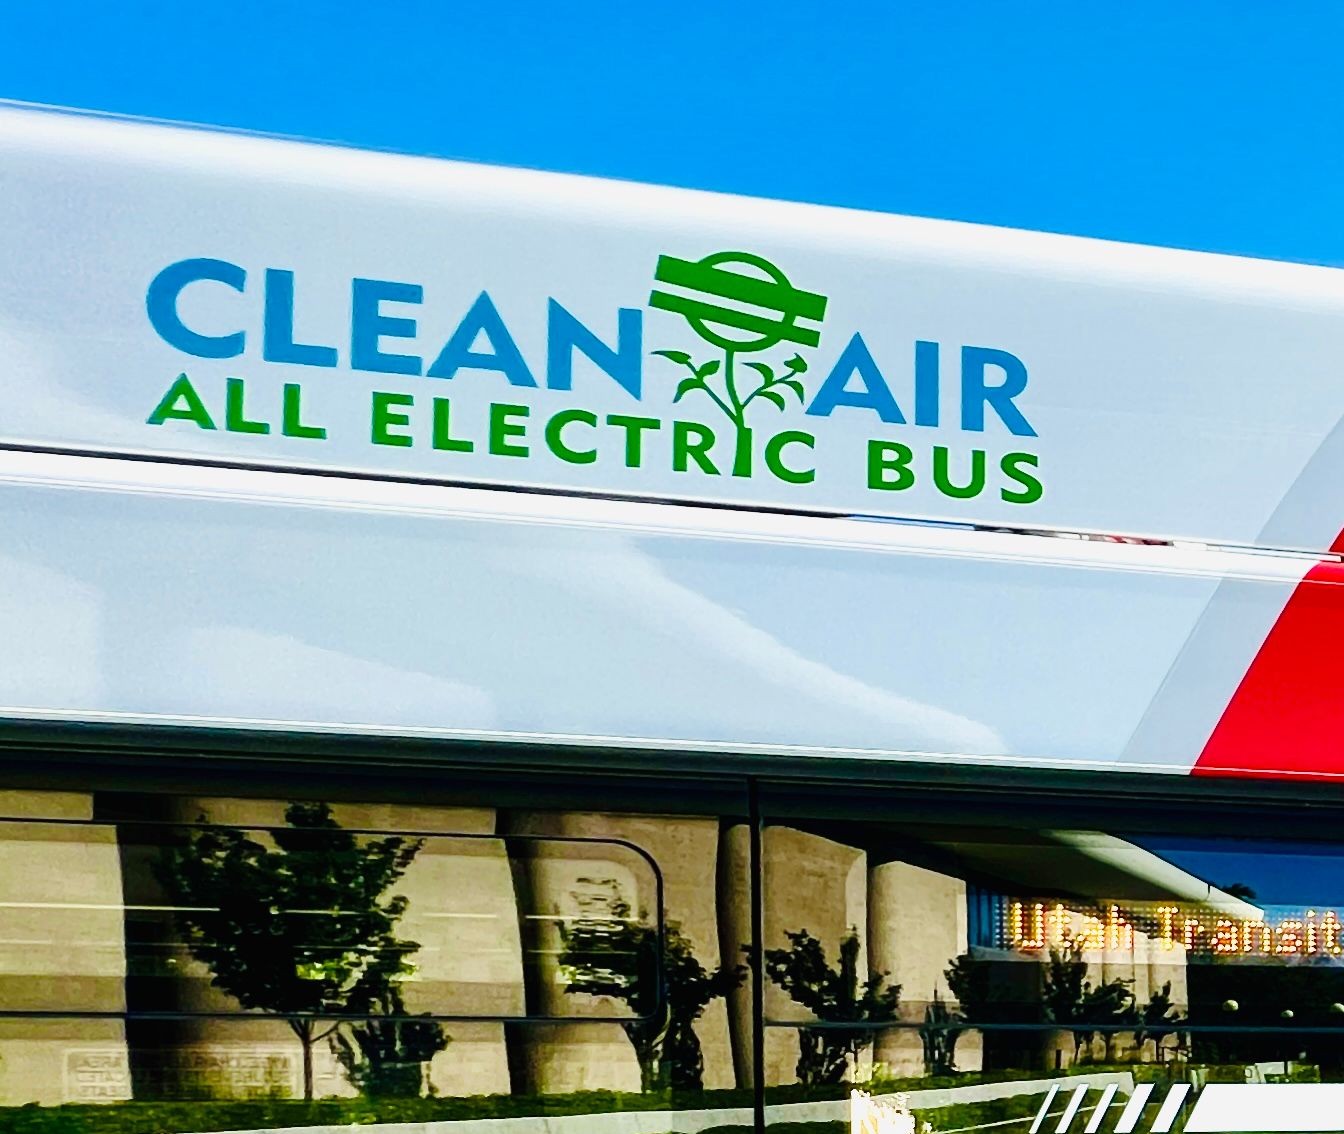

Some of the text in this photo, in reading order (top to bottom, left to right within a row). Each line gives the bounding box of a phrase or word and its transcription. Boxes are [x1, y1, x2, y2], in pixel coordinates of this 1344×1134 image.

[145, 257, 1038, 438] CLEAN AIR
[147, 373, 1044, 505] ALL ELECTRIC BUS
[1010, 902, 1134, 952] Utah
[1156, 905, 1342, 957] Transit
